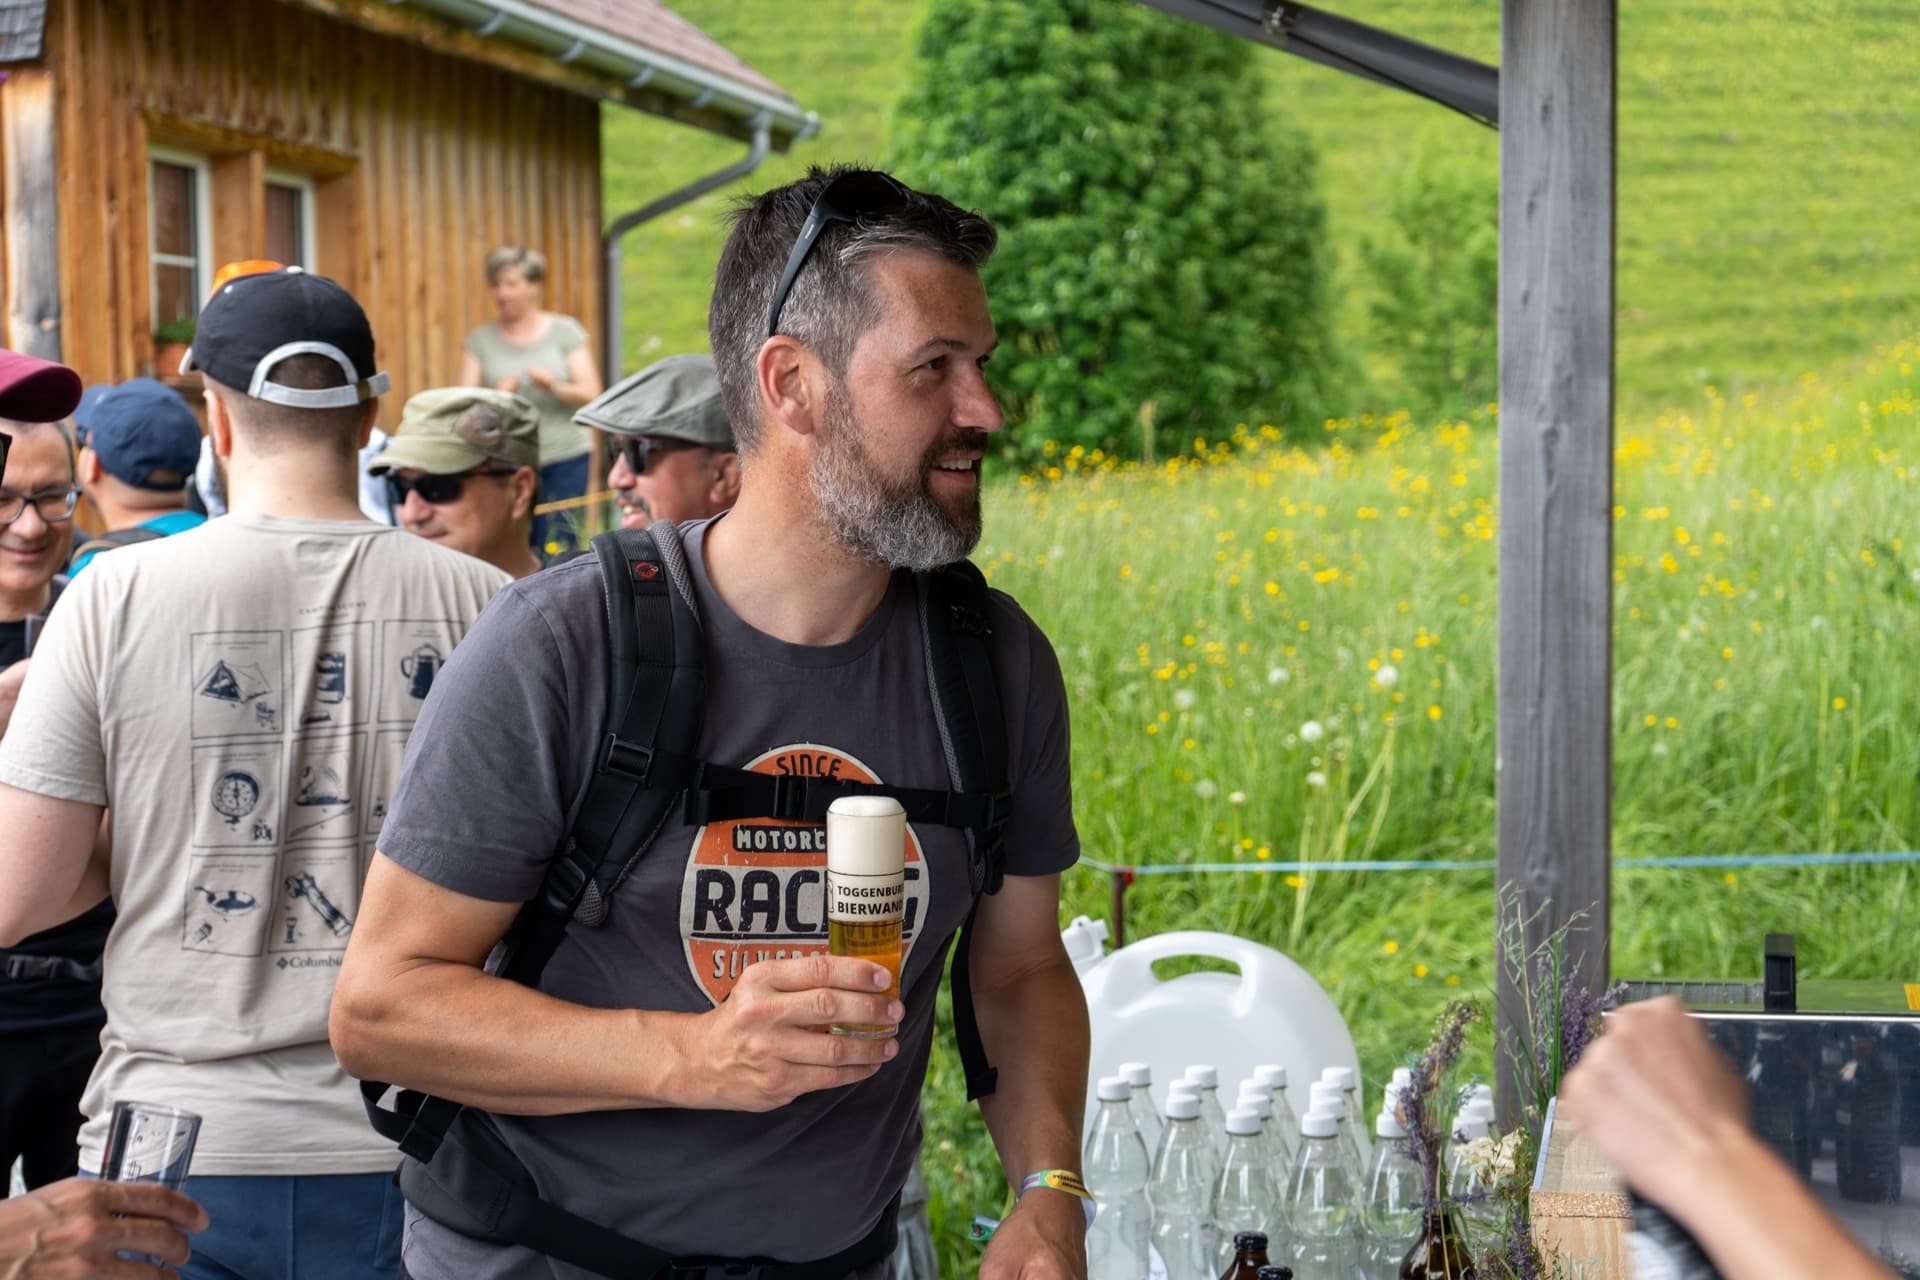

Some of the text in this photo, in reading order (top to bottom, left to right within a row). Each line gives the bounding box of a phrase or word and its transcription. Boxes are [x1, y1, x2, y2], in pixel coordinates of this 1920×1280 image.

[776, 754, 842, 779] SINCE
[737, 830, 826, 850] MOTORC
[693, 868, 920, 932] RAC
[289, 955, 342, 969] Columbi
